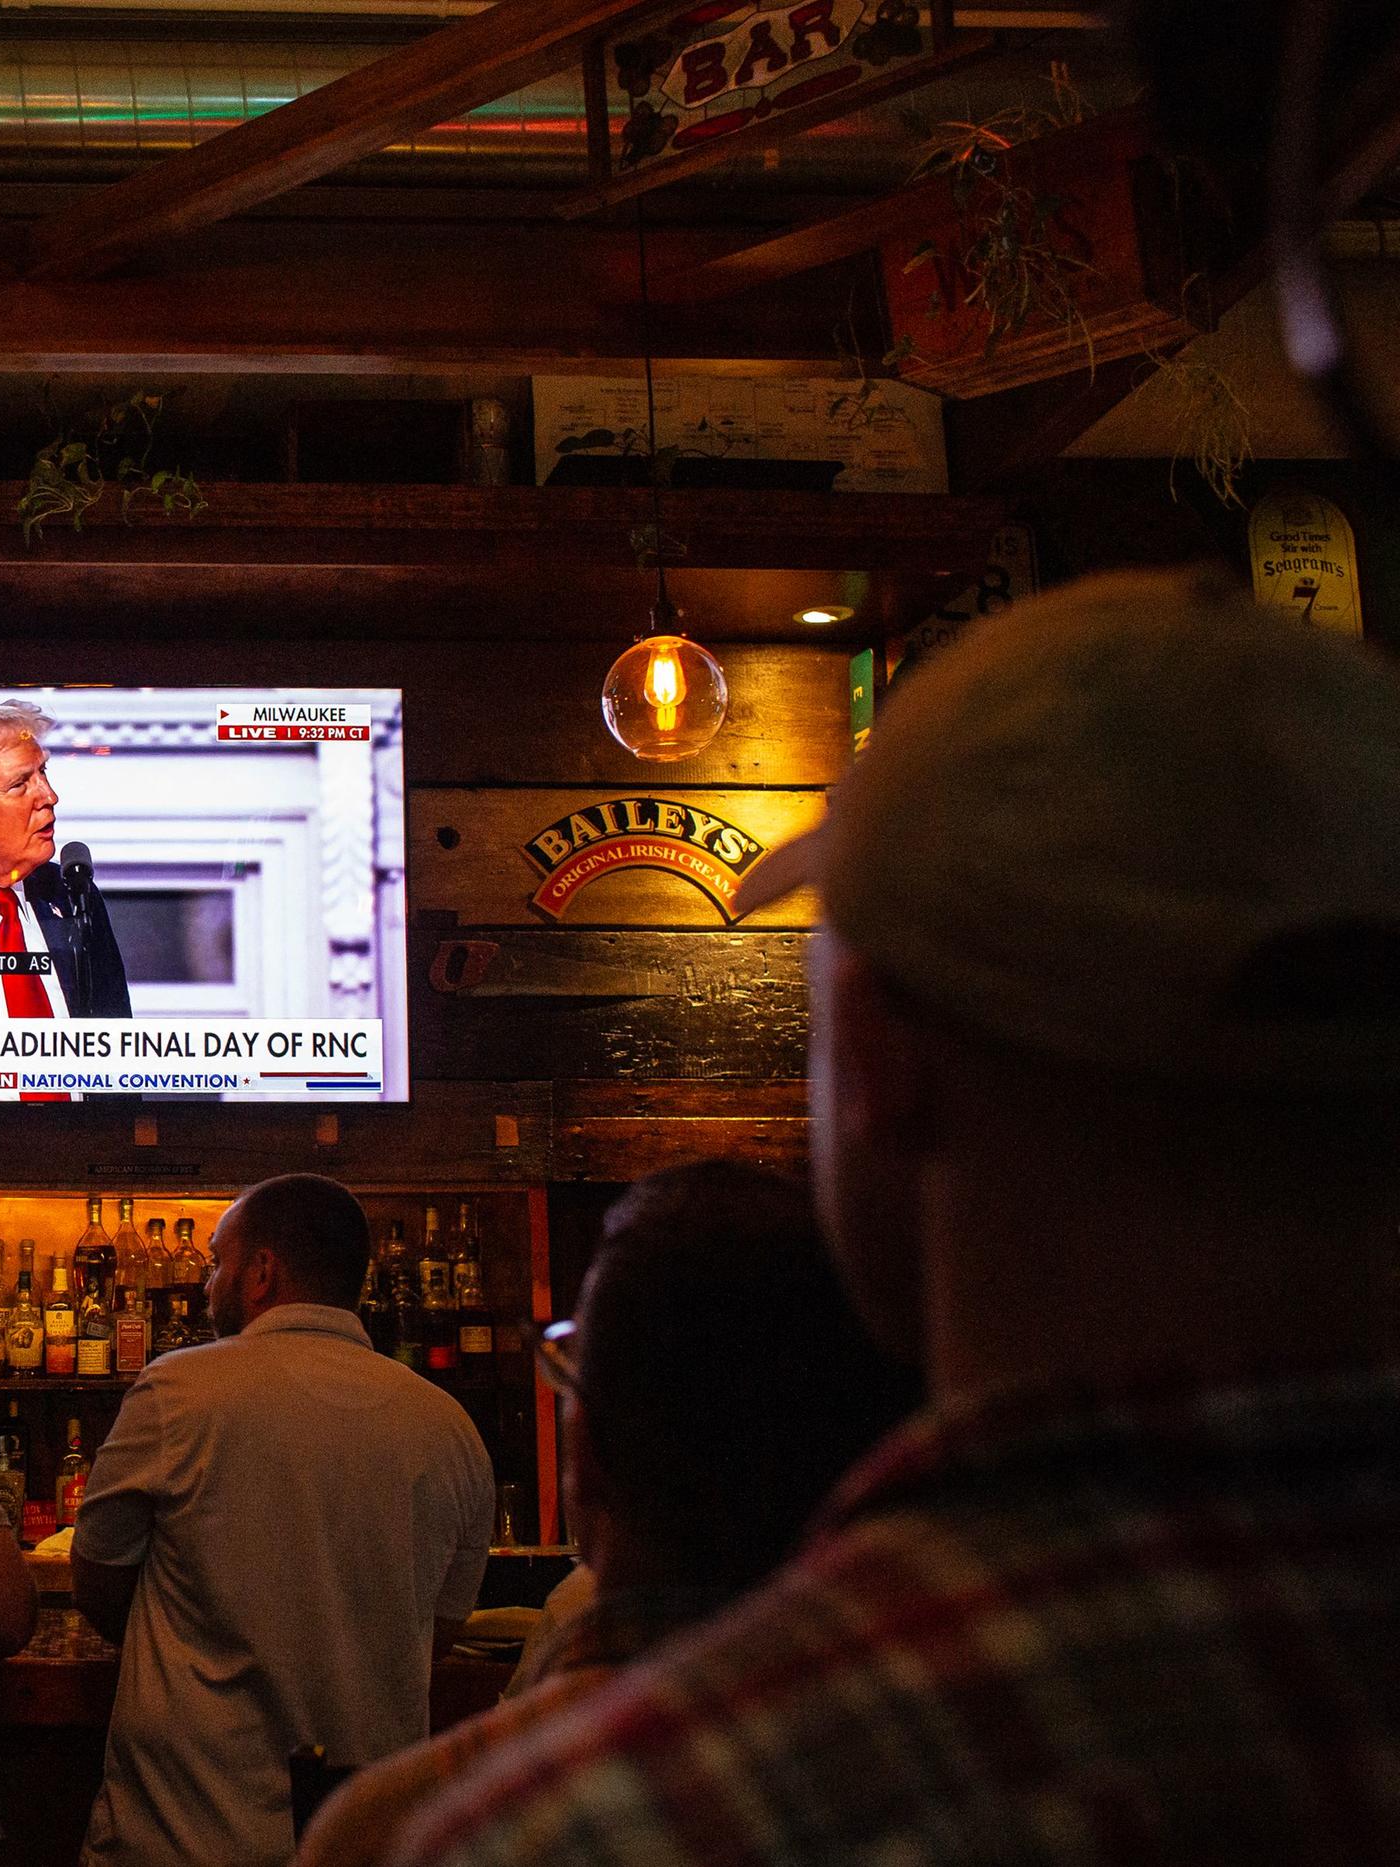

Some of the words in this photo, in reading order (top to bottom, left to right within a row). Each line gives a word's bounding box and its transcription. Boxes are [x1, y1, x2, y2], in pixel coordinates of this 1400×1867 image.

[681, 0, 841, 104] BAR
[1270, 531, 1300, 541] Good
[1302, 531, 1330, 541] Times
[1281, 543, 1297, 552] Stir
[1301, 543, 1322, 552] with
[1263, 558, 1345, 577] Seagram's
[1292, 584, 1321, 624] 7
[253, 707, 346, 721] MILWAUKEE
[228, 727, 277, 738] LIVE
[299, 728, 325, 738] 9:32
[328, 728, 346, 738] PM
[349, 728, 364, 738] CT
[532, 800, 750, 865] BAILEYS
[551, 846, 629, 898] ORIGINAL
[629, 844, 676, 861] IRISH
[677, 852, 737, 900] CREAM
[29, 956, 50, 970] AS
[120, 1031, 196, 1058] FINAL
[204, 1032, 260, 1058] DAY
[267, 1032, 303, 1058] OF
[312, 1032, 368, 1058] RNC
[22, 1073, 114, 1088] NATIONAL
[118, 1073, 238, 1088] CONVENTION
